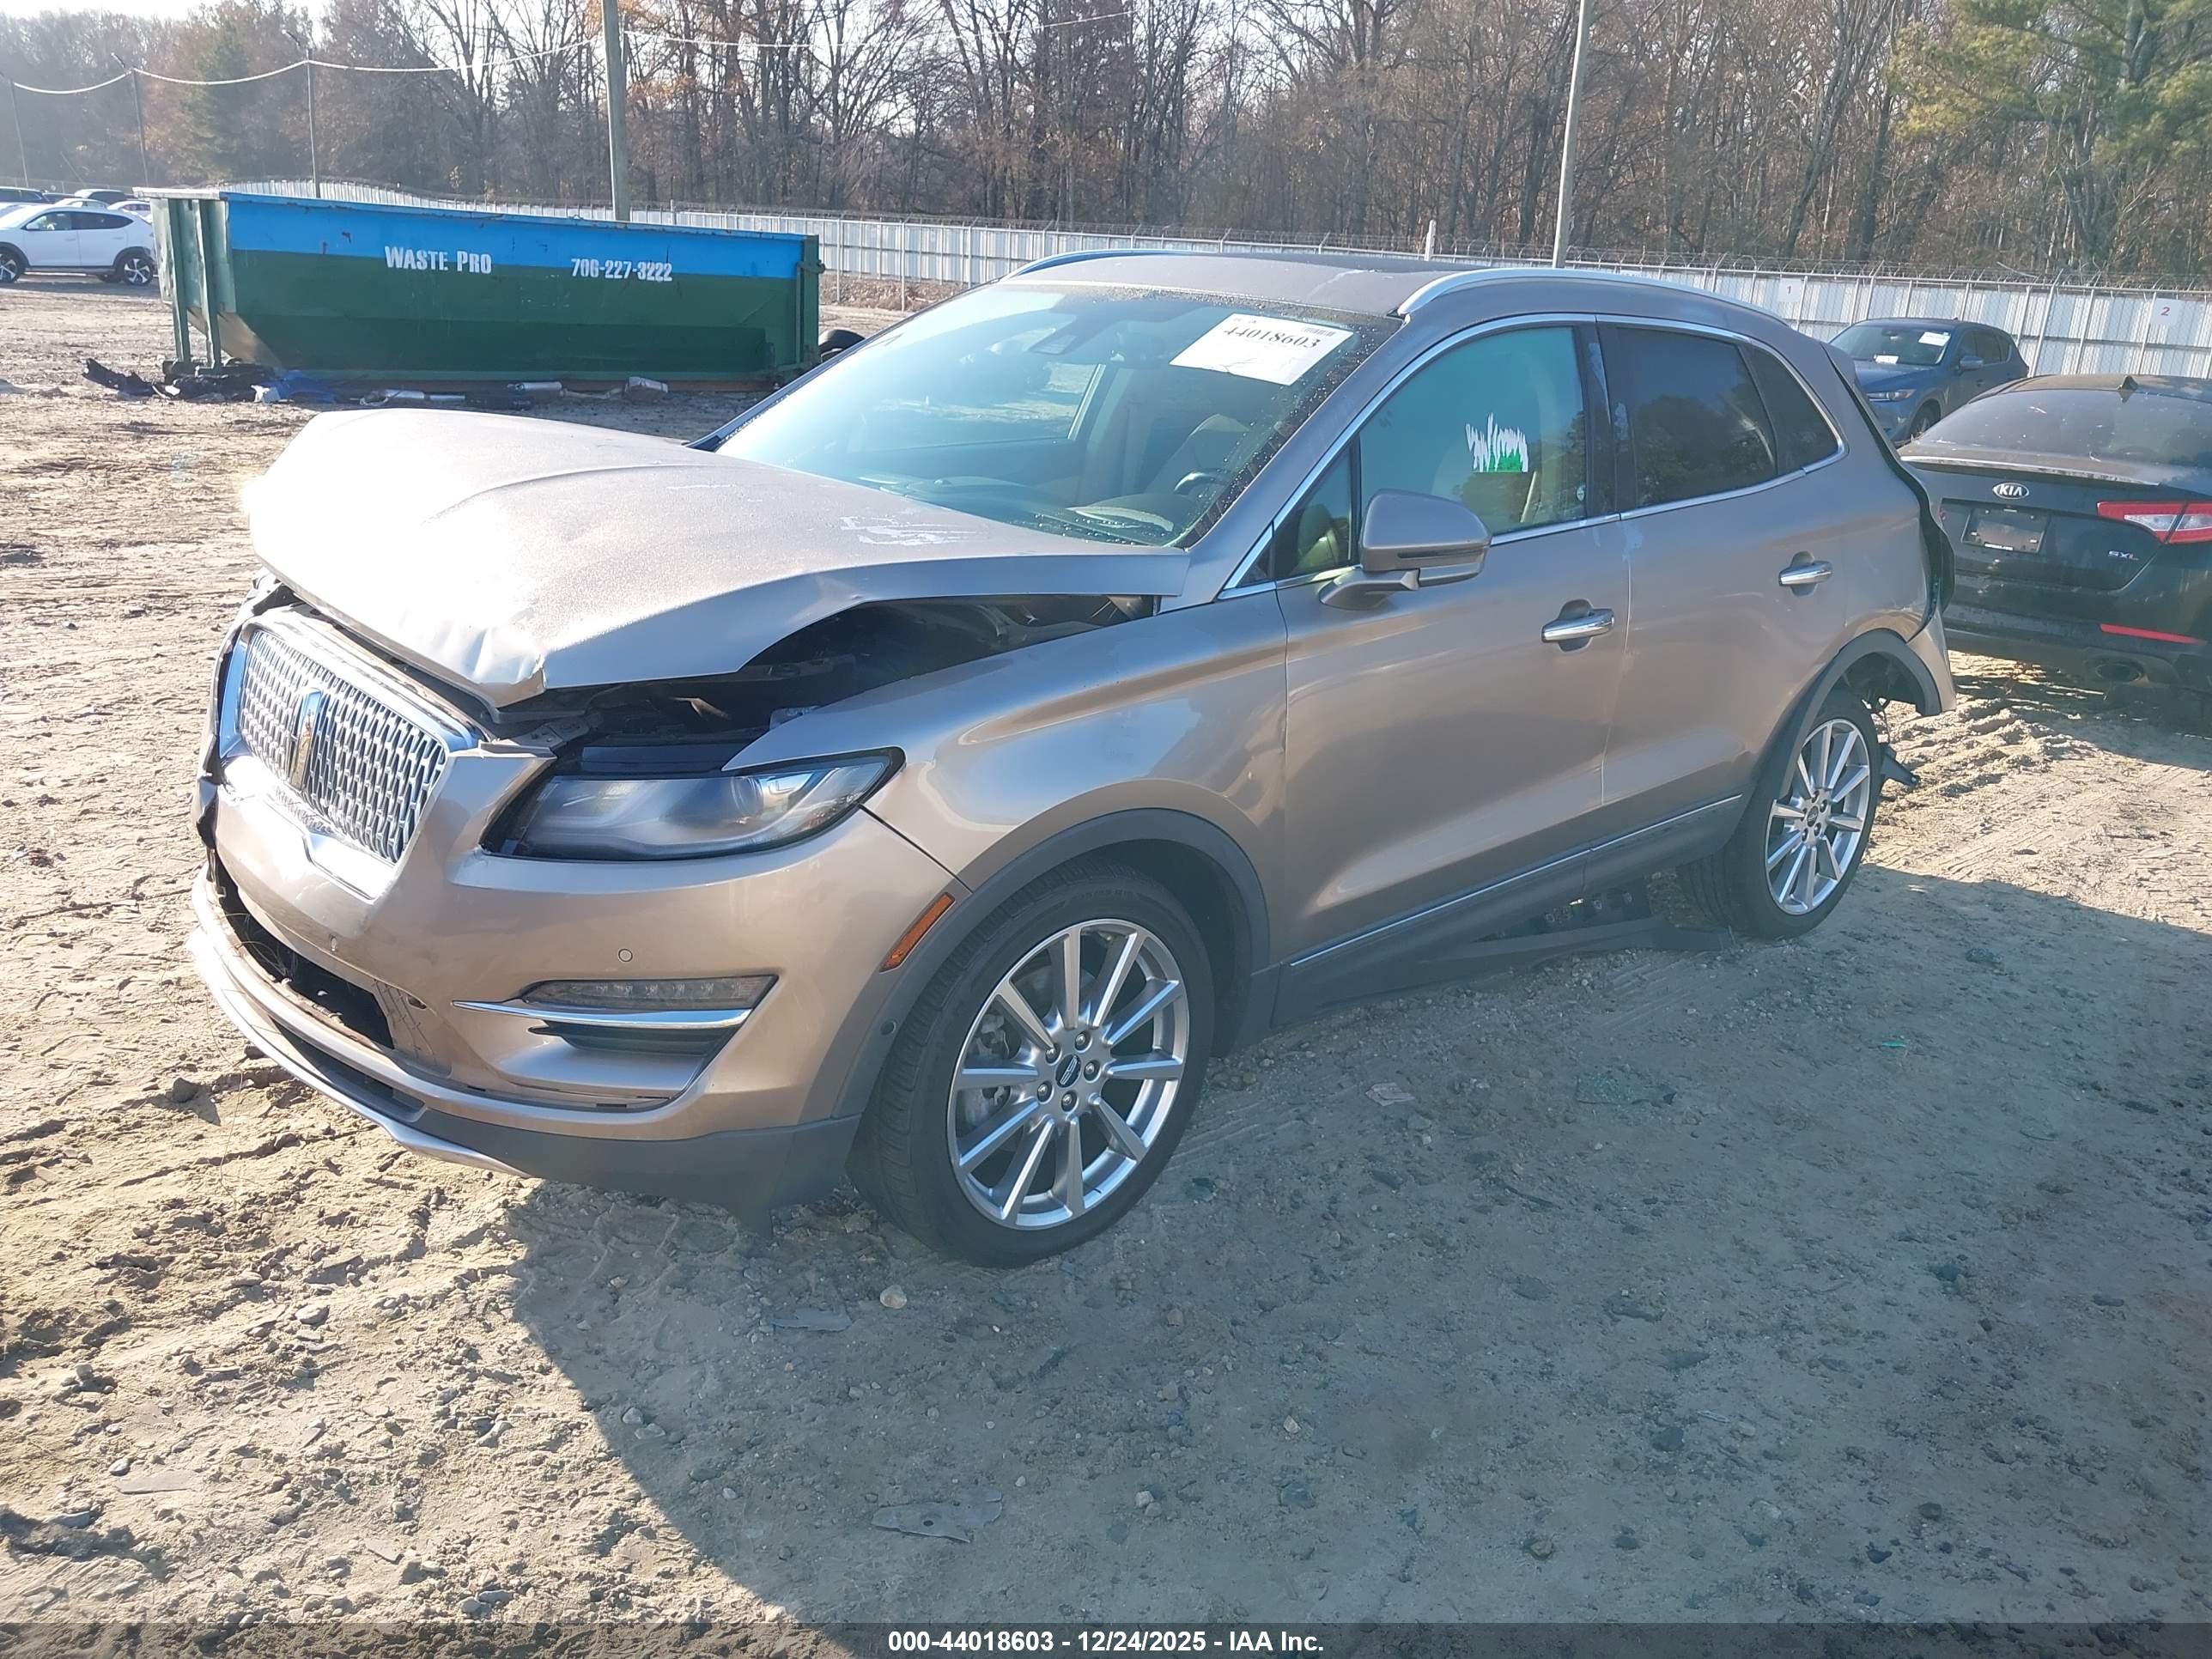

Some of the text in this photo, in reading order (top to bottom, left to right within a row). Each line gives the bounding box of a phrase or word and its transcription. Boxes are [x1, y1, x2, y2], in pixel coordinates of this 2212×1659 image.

[571, 258, 673, 282] 706-227-3222
[2160, 306, 2171, 316] 2
[1224, 326, 1321, 349] 44018603
[1999, 483, 2023, 496] KIA
